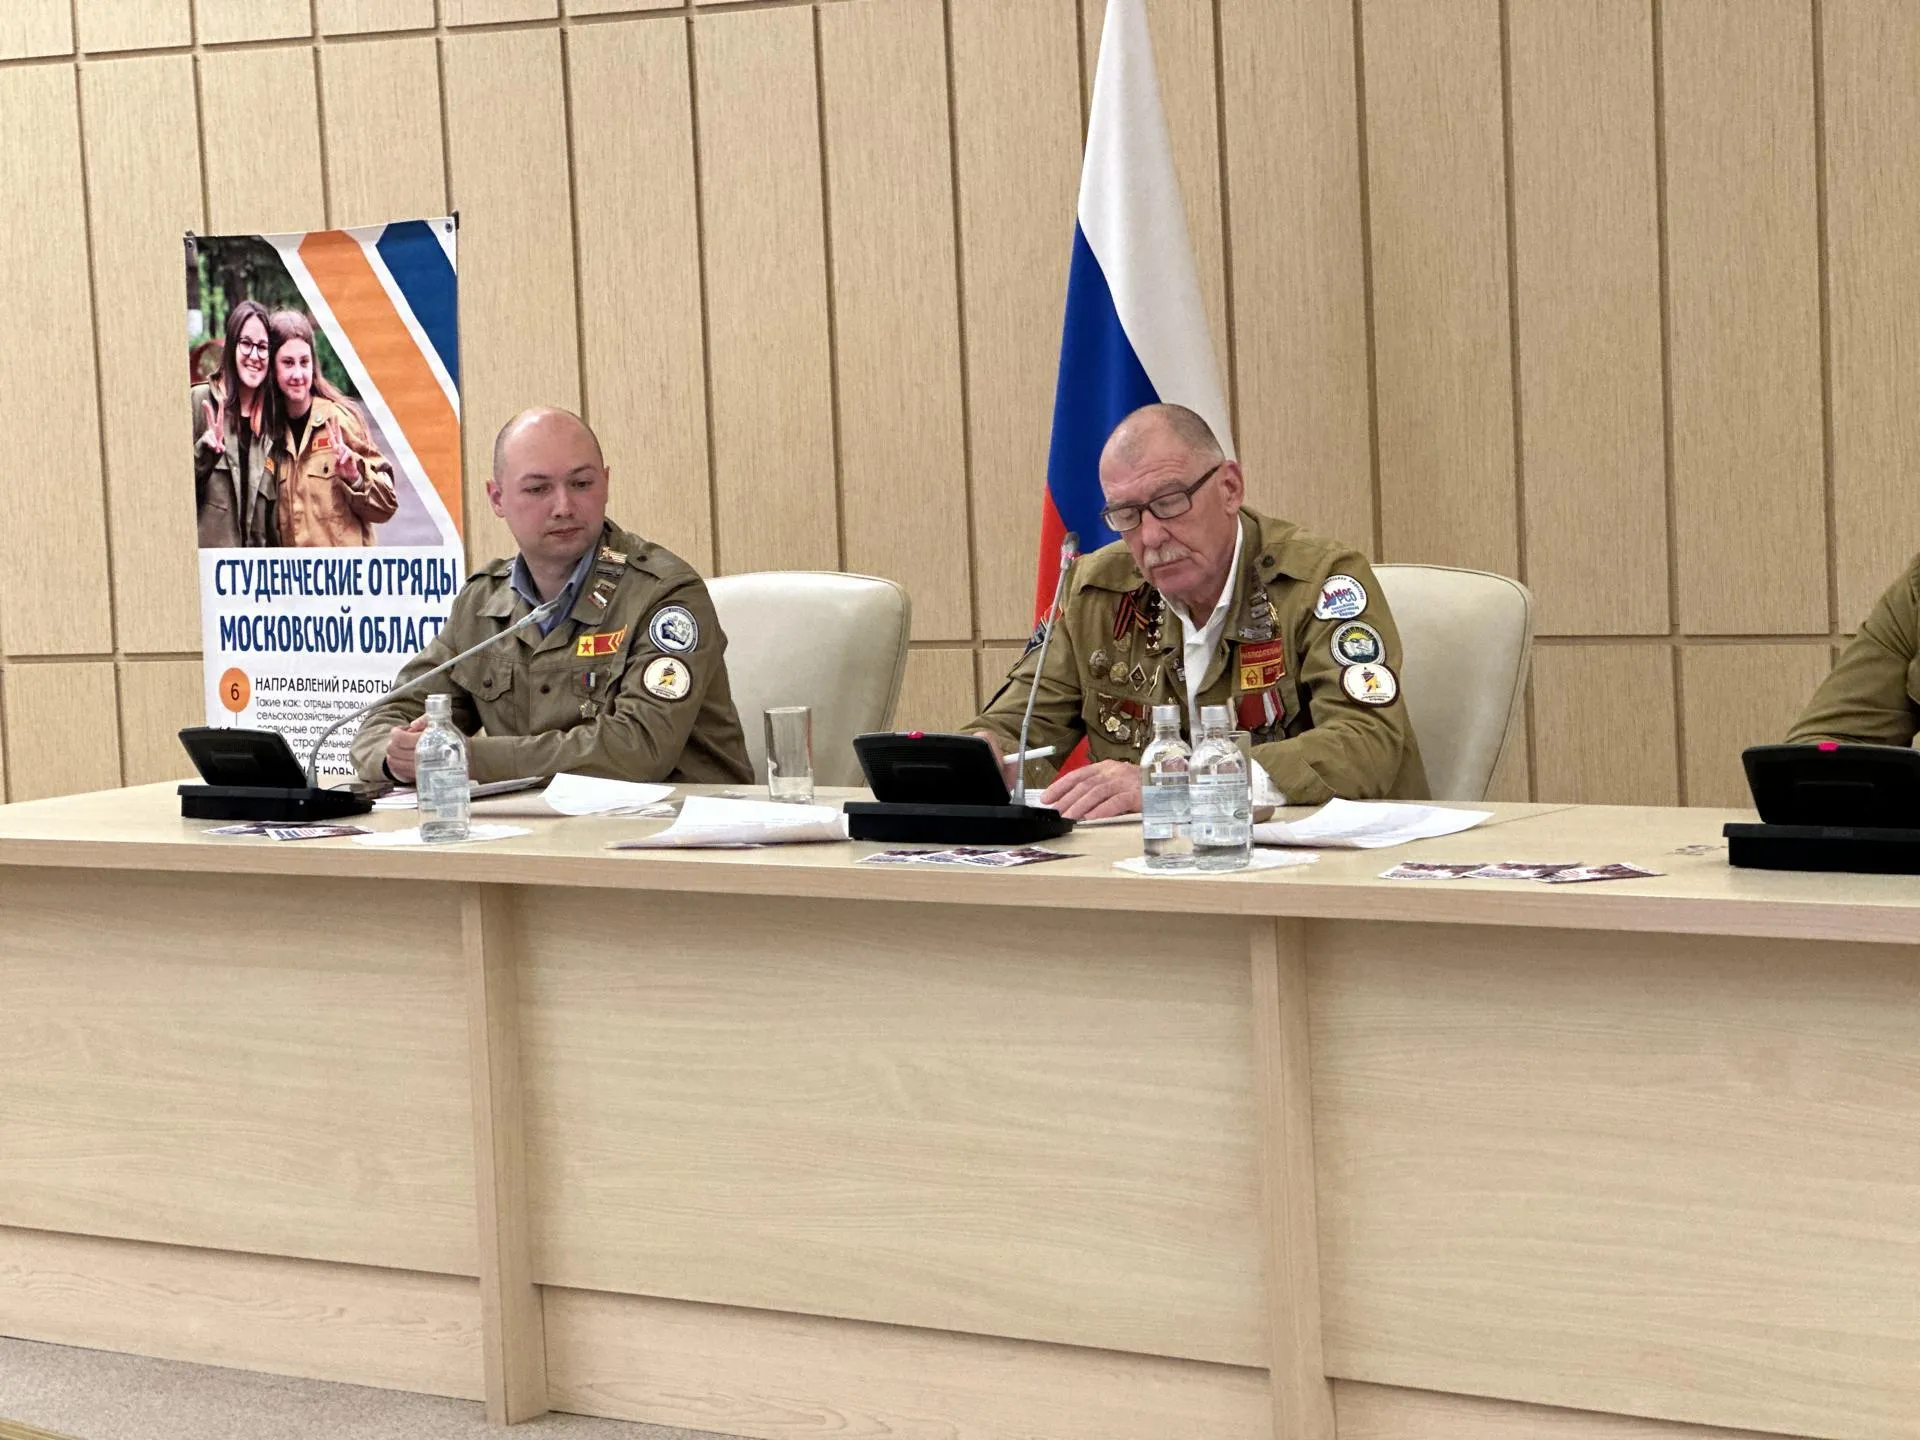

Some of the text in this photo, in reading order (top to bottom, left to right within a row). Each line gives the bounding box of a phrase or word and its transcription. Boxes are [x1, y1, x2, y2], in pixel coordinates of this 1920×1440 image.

[215, 558, 457, 603] СТУДЕНЧЕСКИЕ ОТРЯДЫ
[220, 605, 448, 654] МОСКОВСКОЙ ОБЛАСТ
[230, 683, 240, 701] 6
[255, 676, 392, 694] НАПРАВЛЕНИЙ РАБОТЫ
[256, 696, 281, 708] Такие
[303, 700, 332, 710] отряды
